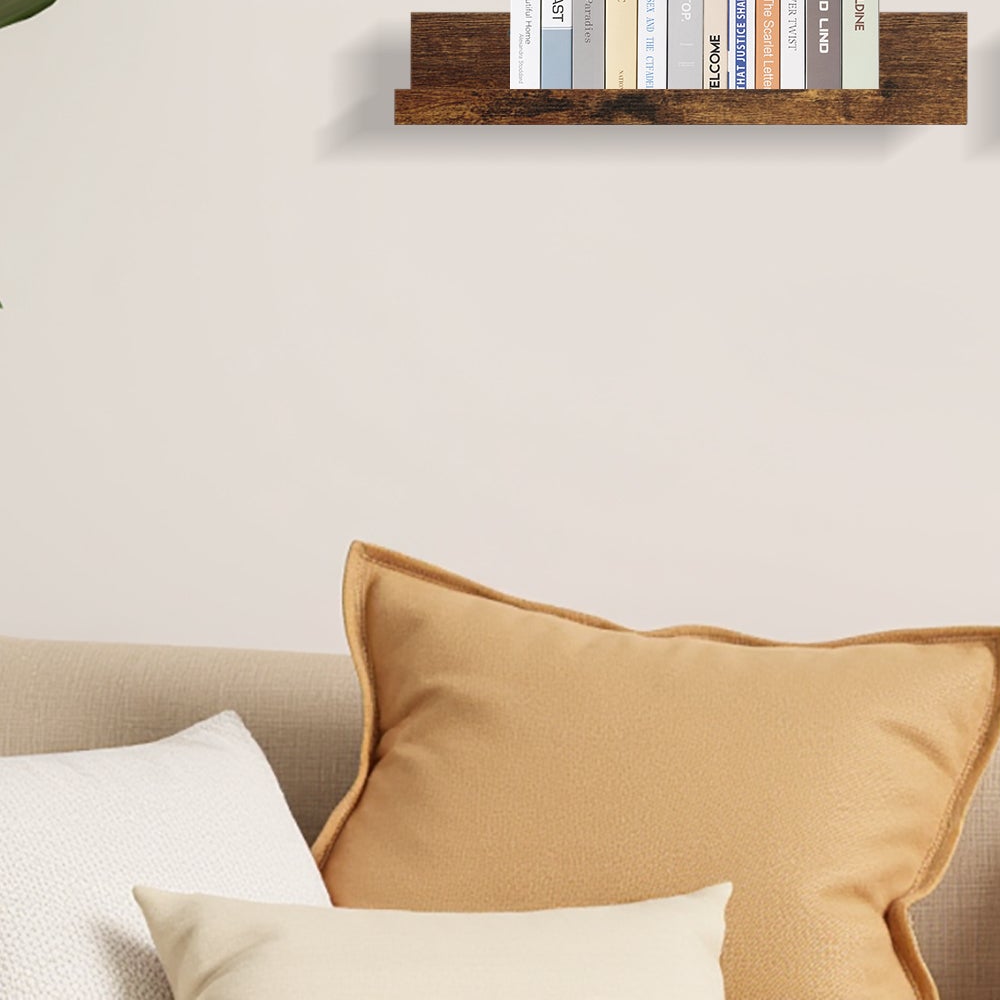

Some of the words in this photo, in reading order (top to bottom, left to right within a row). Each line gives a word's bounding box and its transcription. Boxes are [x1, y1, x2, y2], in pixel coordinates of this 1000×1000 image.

[525, 21, 534, 45] Home
[645, 16, 655, 32] AND
[763, 19, 775, 57] Scarlet
[787, 18, 798, 51] TWIST
[819, 18, 829, 54] LIND
[645, 37, 655, 52] THE
[736, 22, 746, 62] JUSTICE
[709, 34, 721, 89] ELCOME
